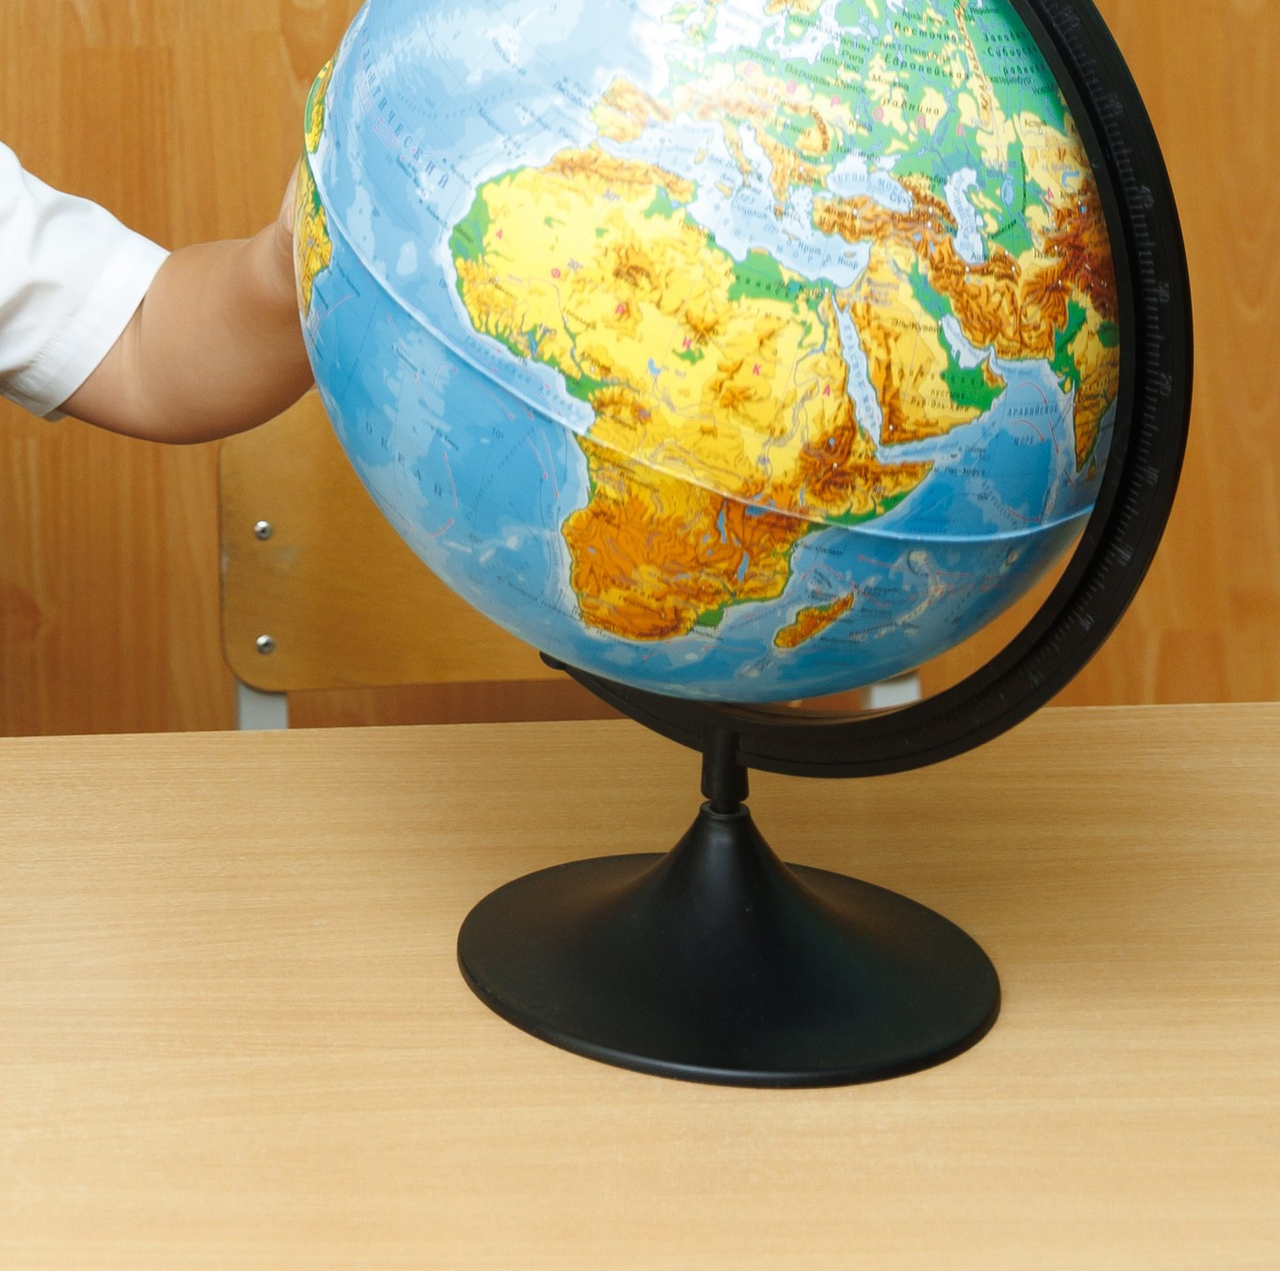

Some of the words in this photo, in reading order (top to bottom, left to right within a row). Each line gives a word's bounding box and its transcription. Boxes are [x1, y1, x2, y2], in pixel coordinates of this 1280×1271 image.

[871, 73, 910, 93] Москва
[797, 240, 822, 257] Крит
[837, 253, 860, 271] Кипр
